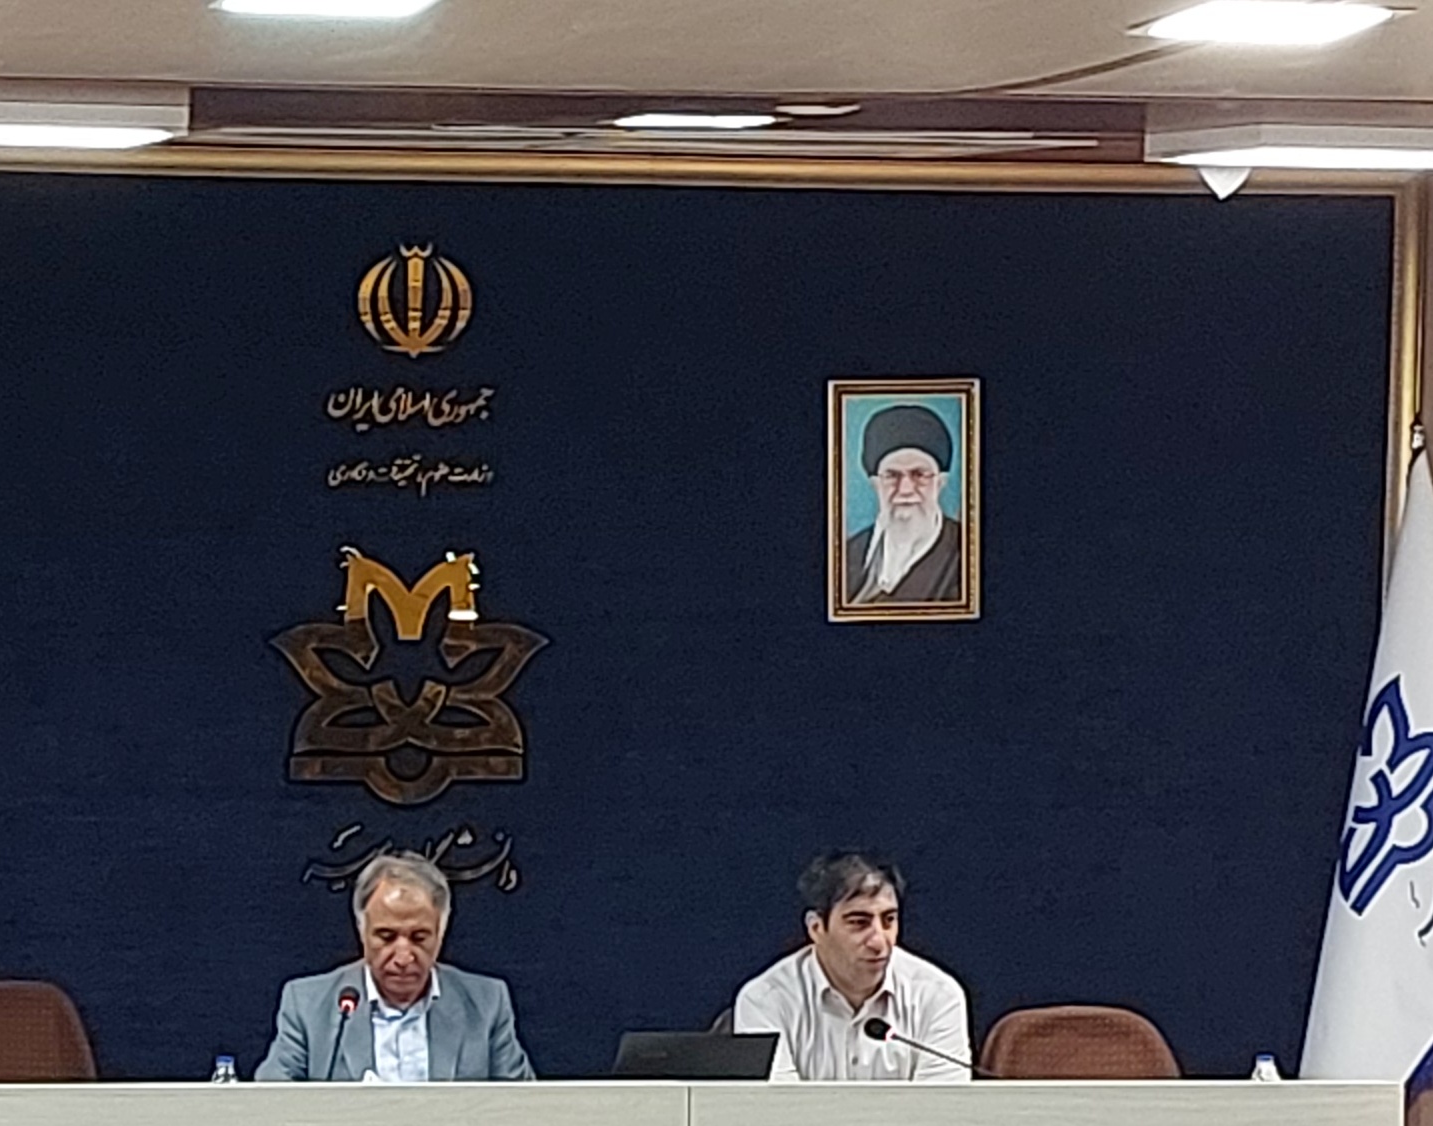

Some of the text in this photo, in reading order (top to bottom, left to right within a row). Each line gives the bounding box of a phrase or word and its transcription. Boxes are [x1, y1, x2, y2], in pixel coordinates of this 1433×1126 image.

[327, 386, 495, 433] جمهوری اسلامی ایران
